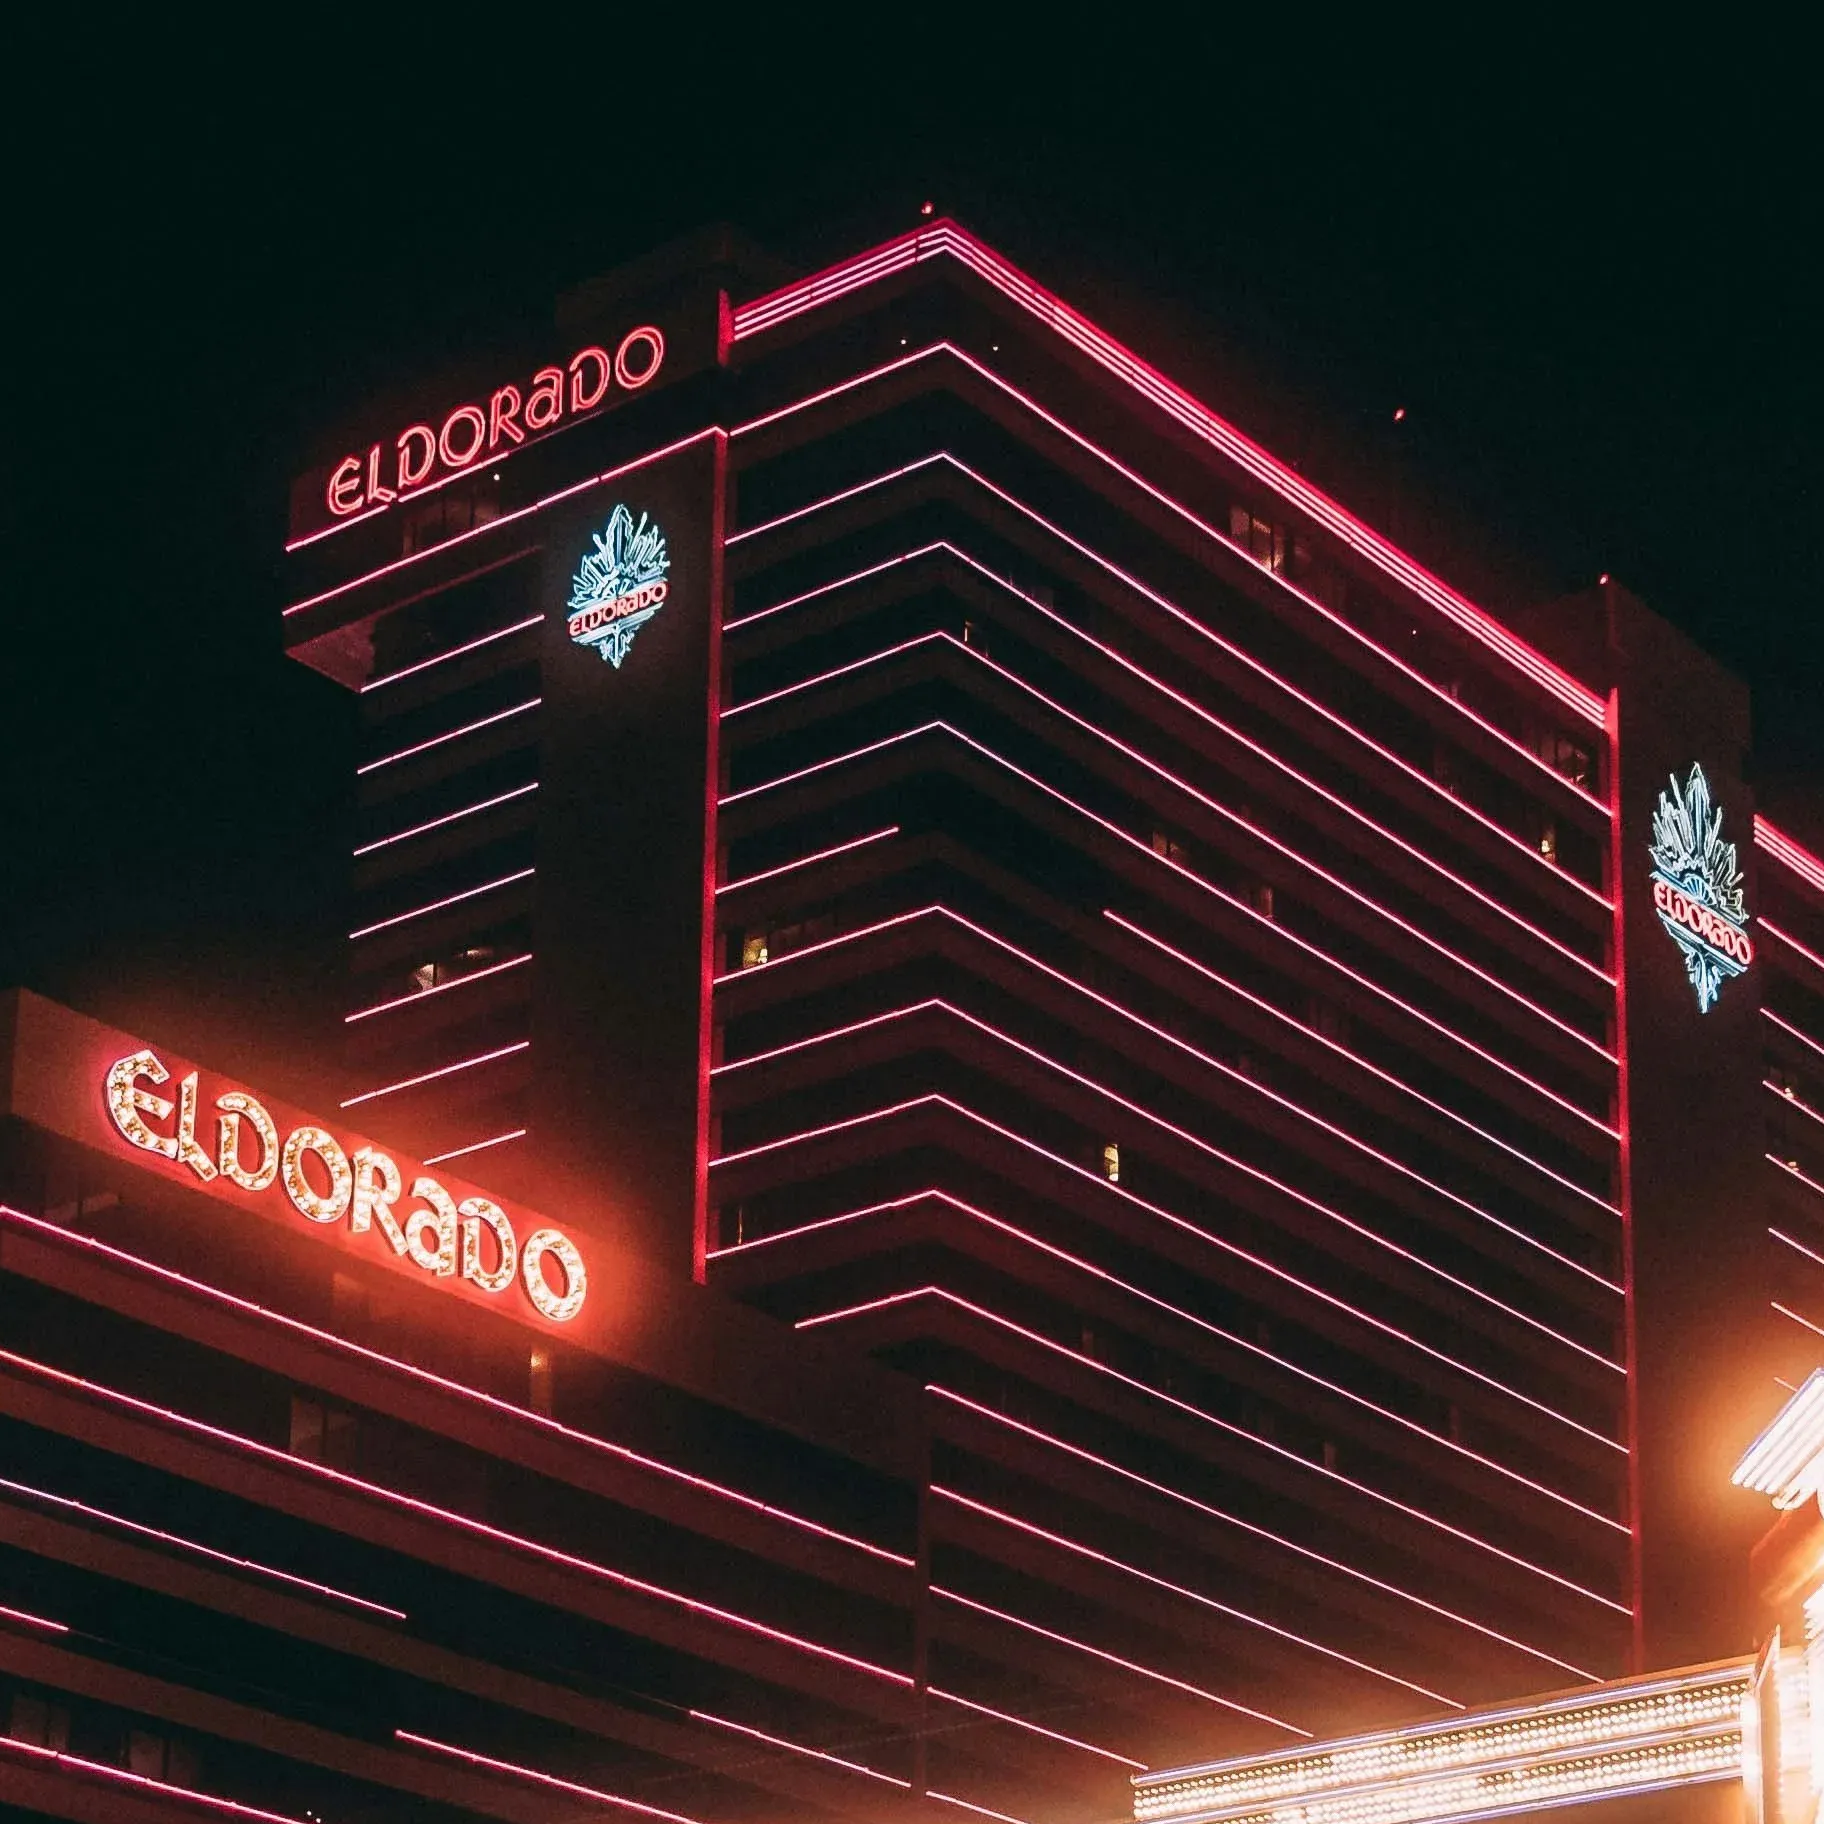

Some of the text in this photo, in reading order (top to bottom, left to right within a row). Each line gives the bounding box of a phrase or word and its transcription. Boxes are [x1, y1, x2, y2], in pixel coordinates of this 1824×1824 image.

[326, 325, 666, 516] ELDORADO
[568, 582, 668, 638] ELDORADO
[1653, 879, 1753, 965] ELDORADO
[106, 1048, 587, 1323] ELDORADO
